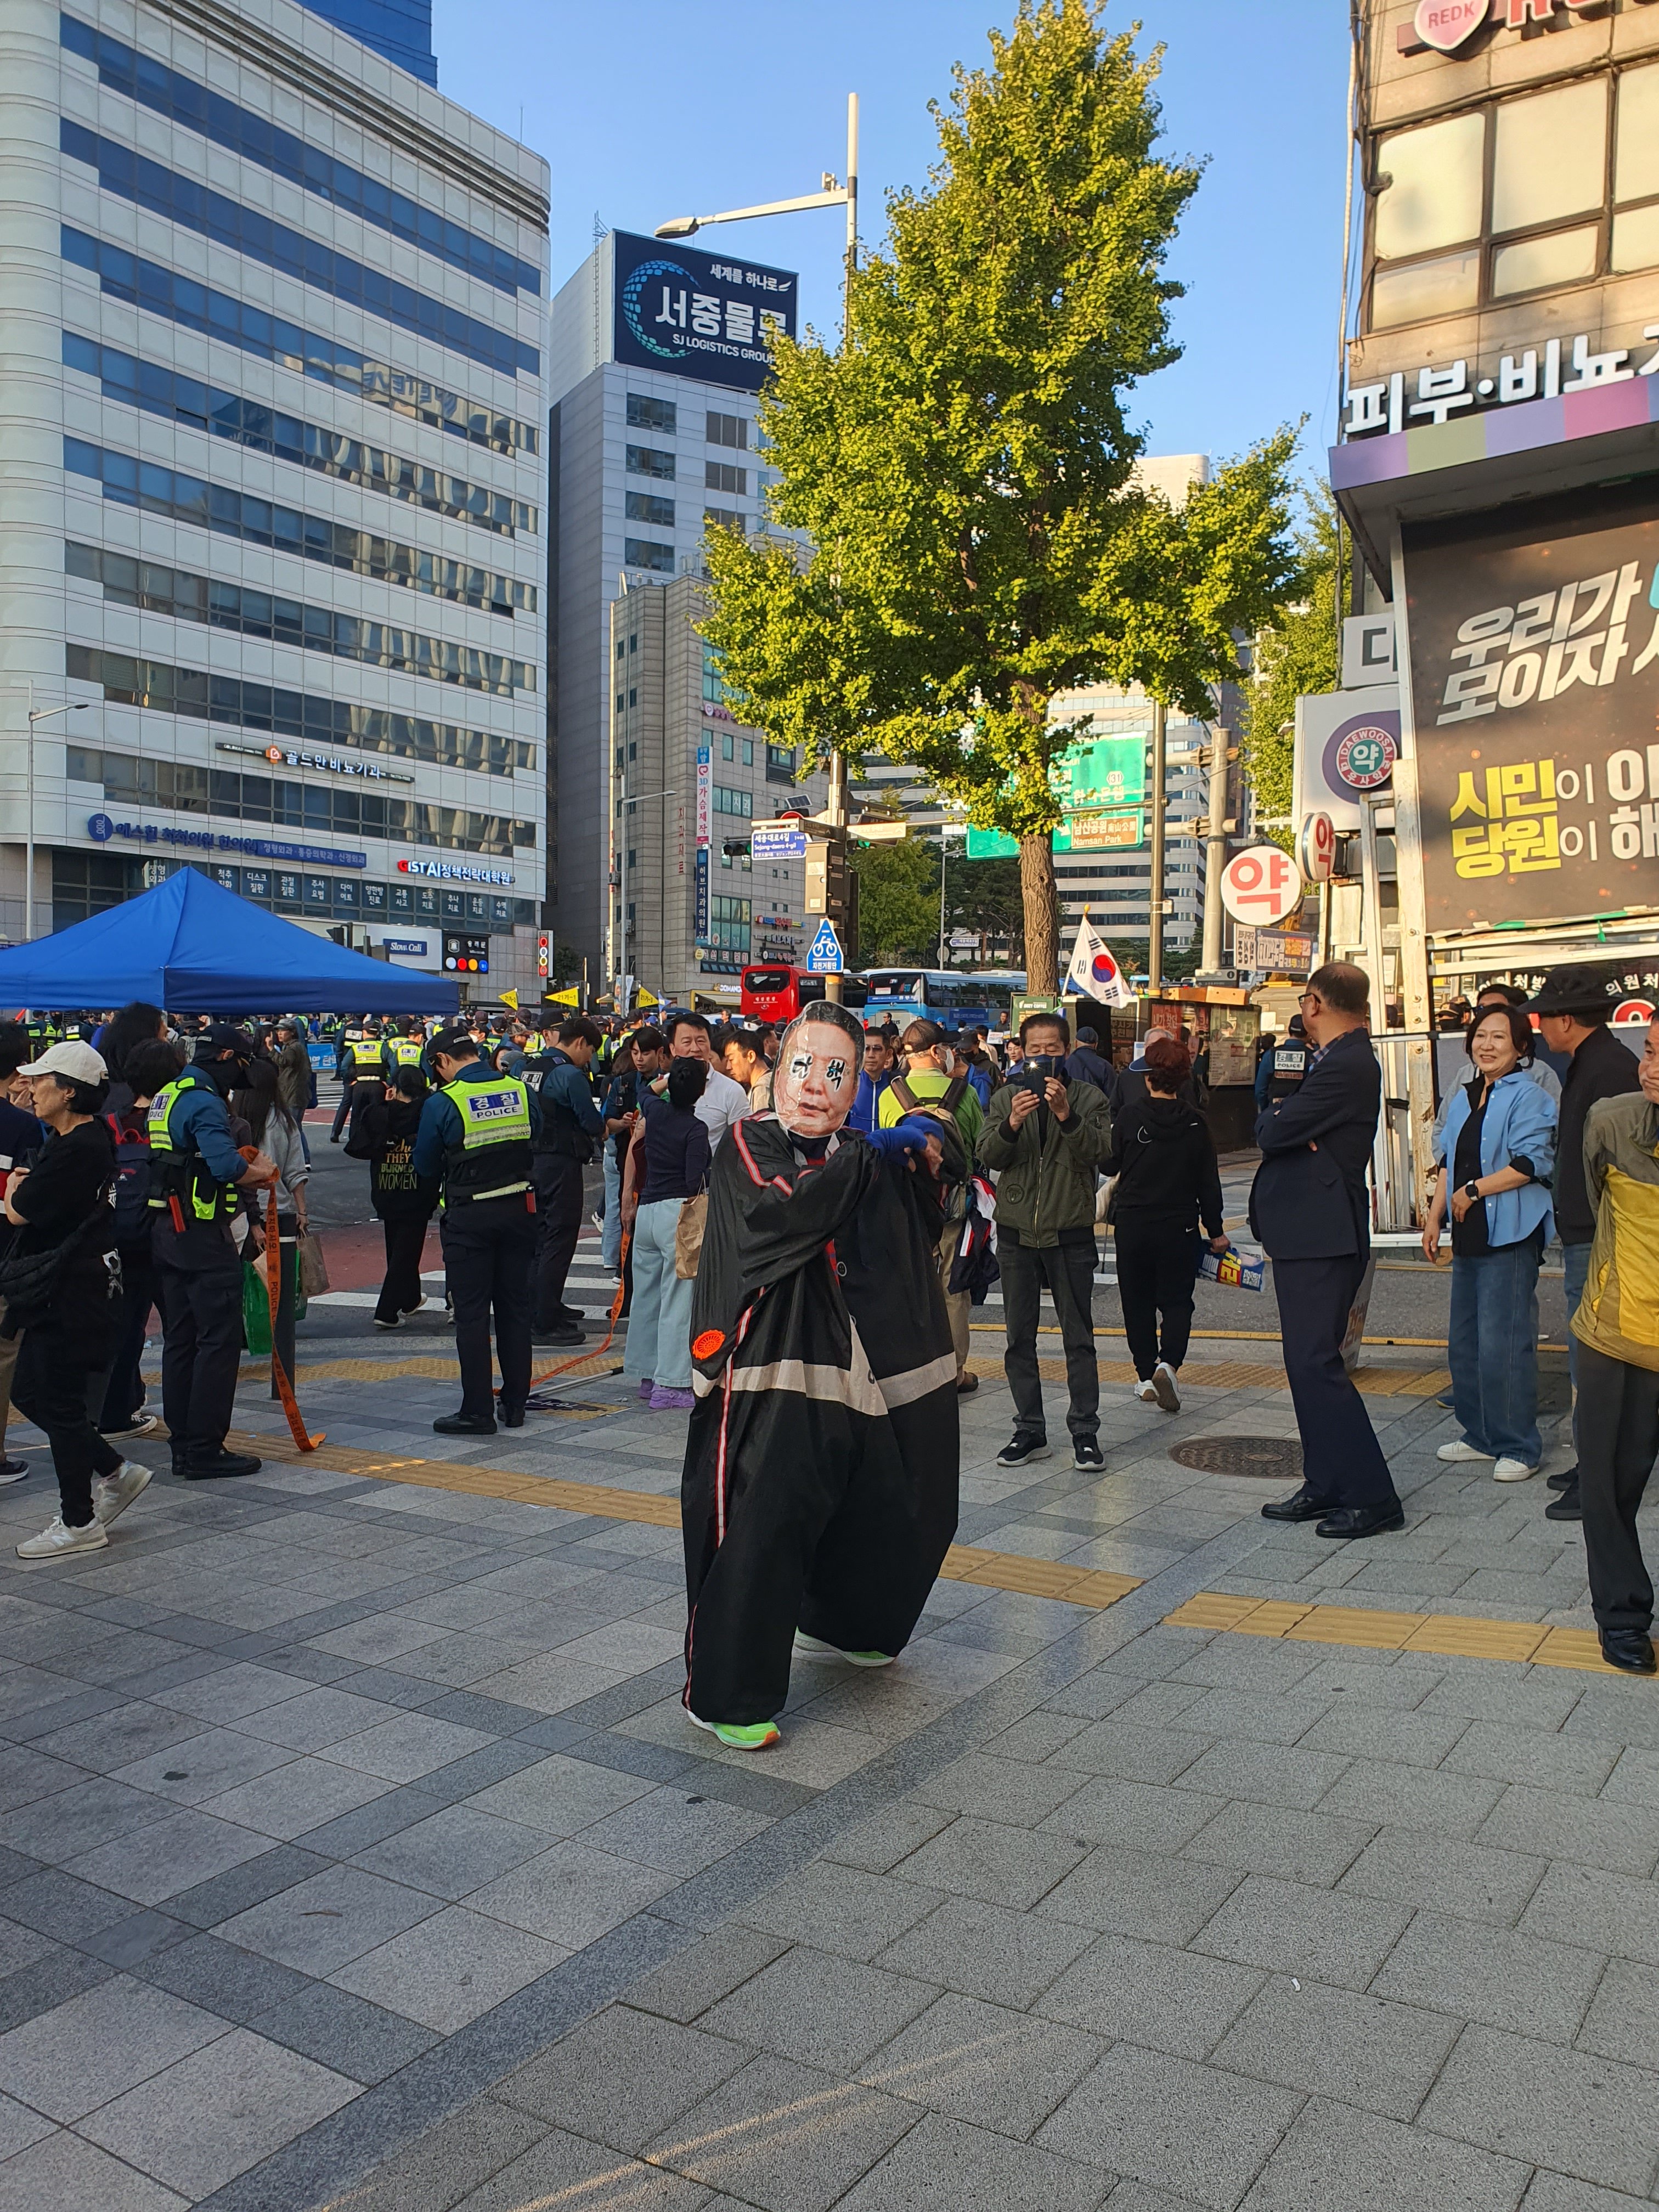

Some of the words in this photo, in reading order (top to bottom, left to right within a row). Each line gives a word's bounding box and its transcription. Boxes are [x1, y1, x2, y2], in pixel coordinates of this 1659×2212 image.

[1428, 4, 1475, 28] REDK
[710, 263, 742, 284] 세계를
[745, 272, 777, 292] 하나로
[673, 333, 685, 346] SJ
[686, 336, 740, 357] LOGISTICS
[1451, 560, 1643, 668] 우리가
[1436, 623, 1628, 726] 모이자
[1340, 730, 1393, 755] DAEWOOSA
[1353, 744, 1379, 770] 약
[698, 777, 708, 786] 3D
[1450, 759, 1594, 822] 시민이
[1074, 821, 1107, 836] 남산공원
[1108, 821, 1137, 833] 南山公園
[754, 832, 790, 843] 세종대로4길
[1074, 837, 1102, 846] Namsan
[1105, 835, 1122, 844] Park
[263, 843, 293, 855] 정형외과
[1452, 815, 1598, 878] 당원이
[398, 860, 426, 873] GIST
[247, 872, 267, 881] 디스크
[1229, 855, 1289, 915] 약
[390, 942, 407, 951] Slow
[408, 943, 422, 952] Cali
[812, 962, 837, 970] 자전거횡단
[475, 1093, 515, 1109] 경찰
[477, 1107, 517, 1119] POLICE
[386, 1153, 413, 1164] THEY
[379, 1173, 417, 1190] WOMEN
